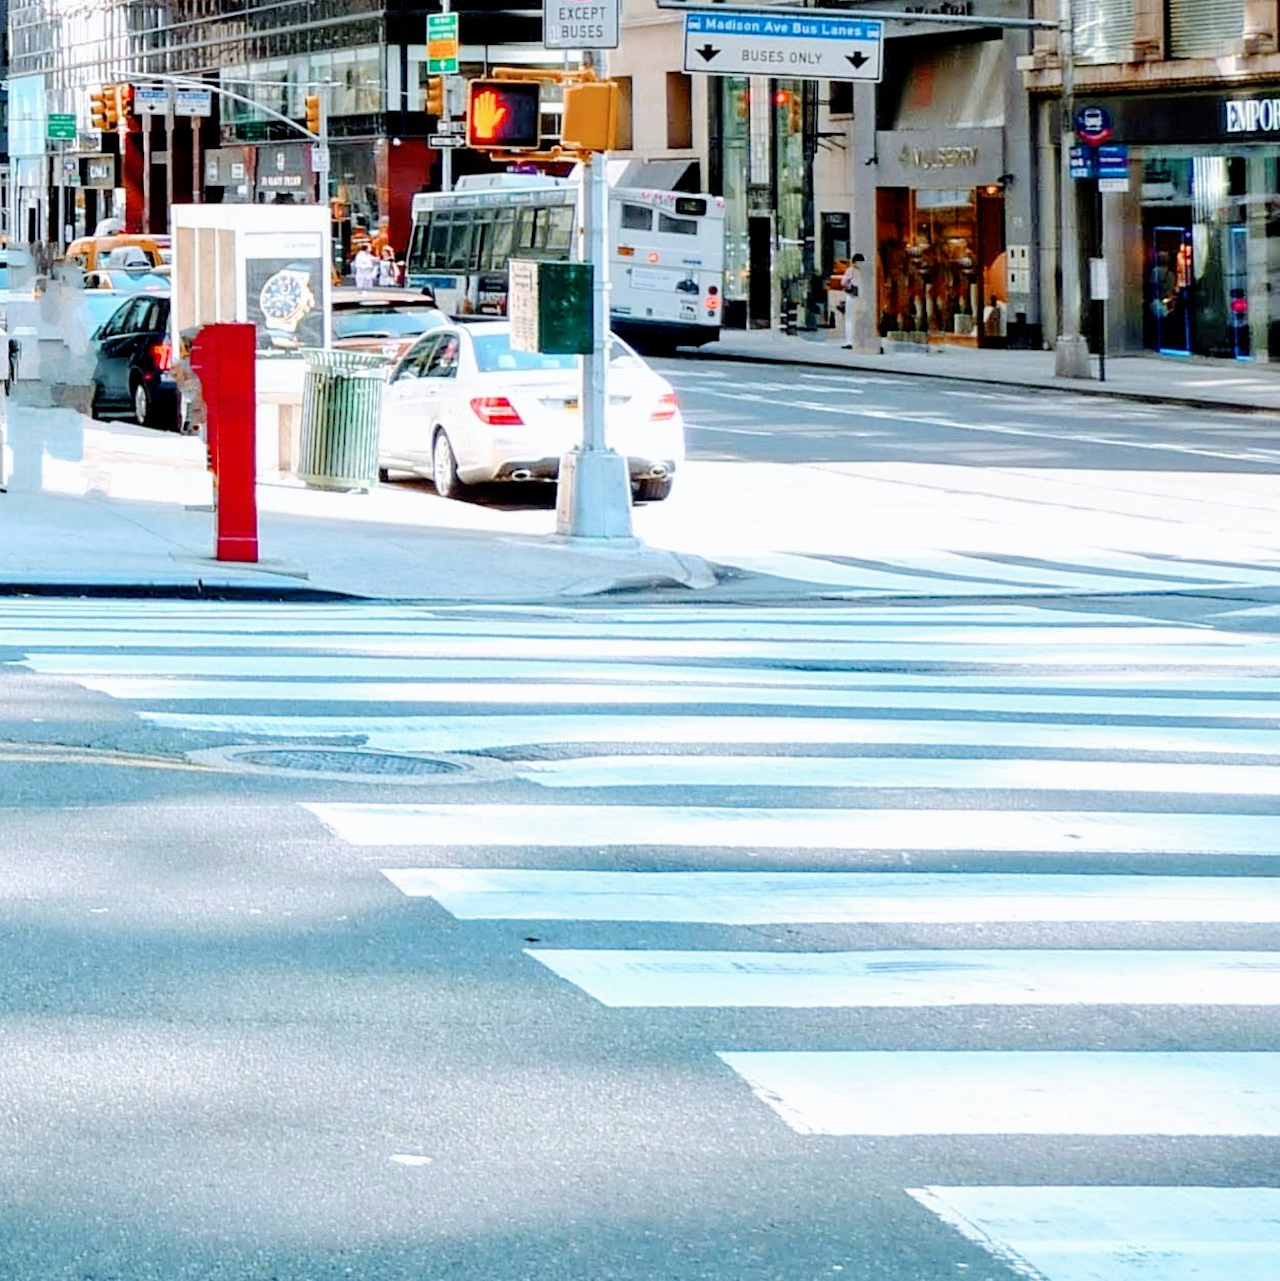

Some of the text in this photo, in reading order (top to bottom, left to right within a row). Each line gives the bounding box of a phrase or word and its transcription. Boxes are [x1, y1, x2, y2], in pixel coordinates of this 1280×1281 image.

[559, 7, 607, 21] EXCEPT
[561, 25, 604, 39] BUSES
[705, 18, 862, 38] Madison Ave Bus Lanes
[742, 49, 824, 65] BUSES ONLY
